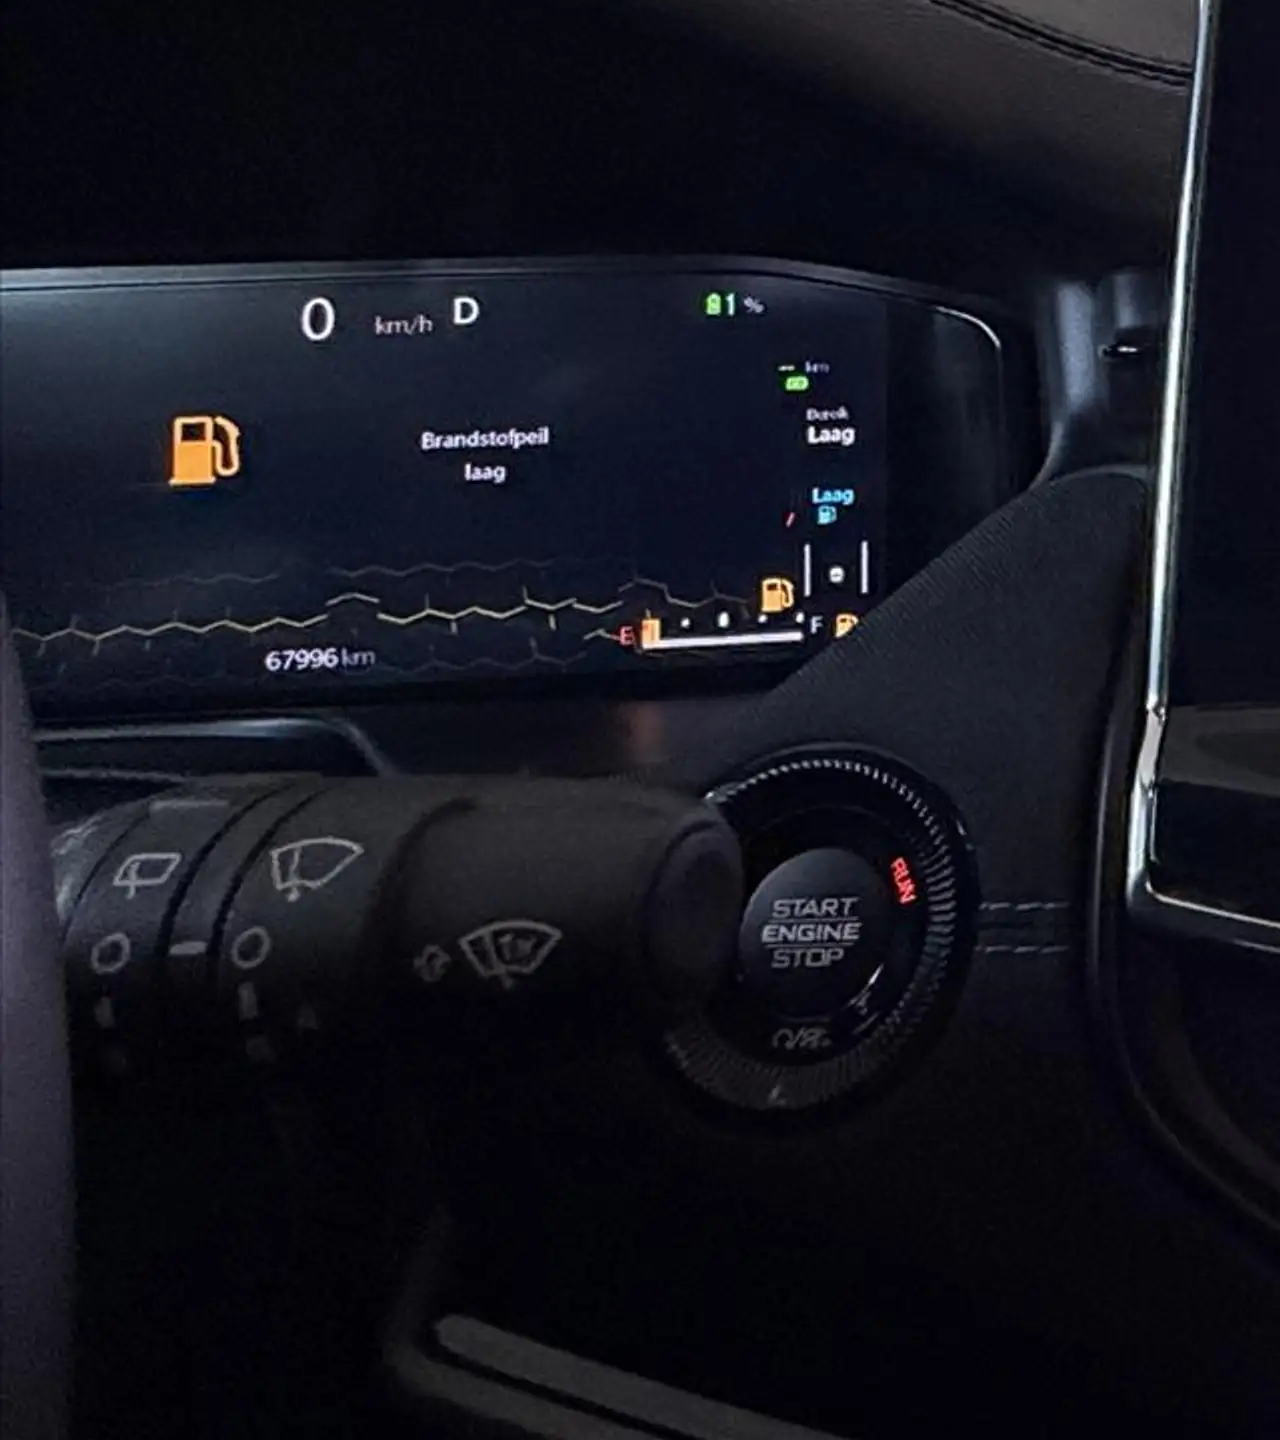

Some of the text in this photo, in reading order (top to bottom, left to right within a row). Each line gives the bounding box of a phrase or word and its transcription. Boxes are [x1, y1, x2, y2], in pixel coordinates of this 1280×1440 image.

[302, 297, 433, 341] 0 km/h
[453, 296, 480, 325] D
[421, 426, 550, 450] Brandstofpeil
[807, 426, 855, 446] Laag
[464, 462, 506, 484] laag
[812, 487, 854, 505] Laag
[619, 626, 635, 645] E
[810, 615, 823, 634] F
[265, 648, 375, 671] 67996 km
[890, 856, 918, 905] RUN
[772, 896, 859, 919] START
[760, 922, 863, 943] ENGINE
[770, 947, 844, 969] STOP
